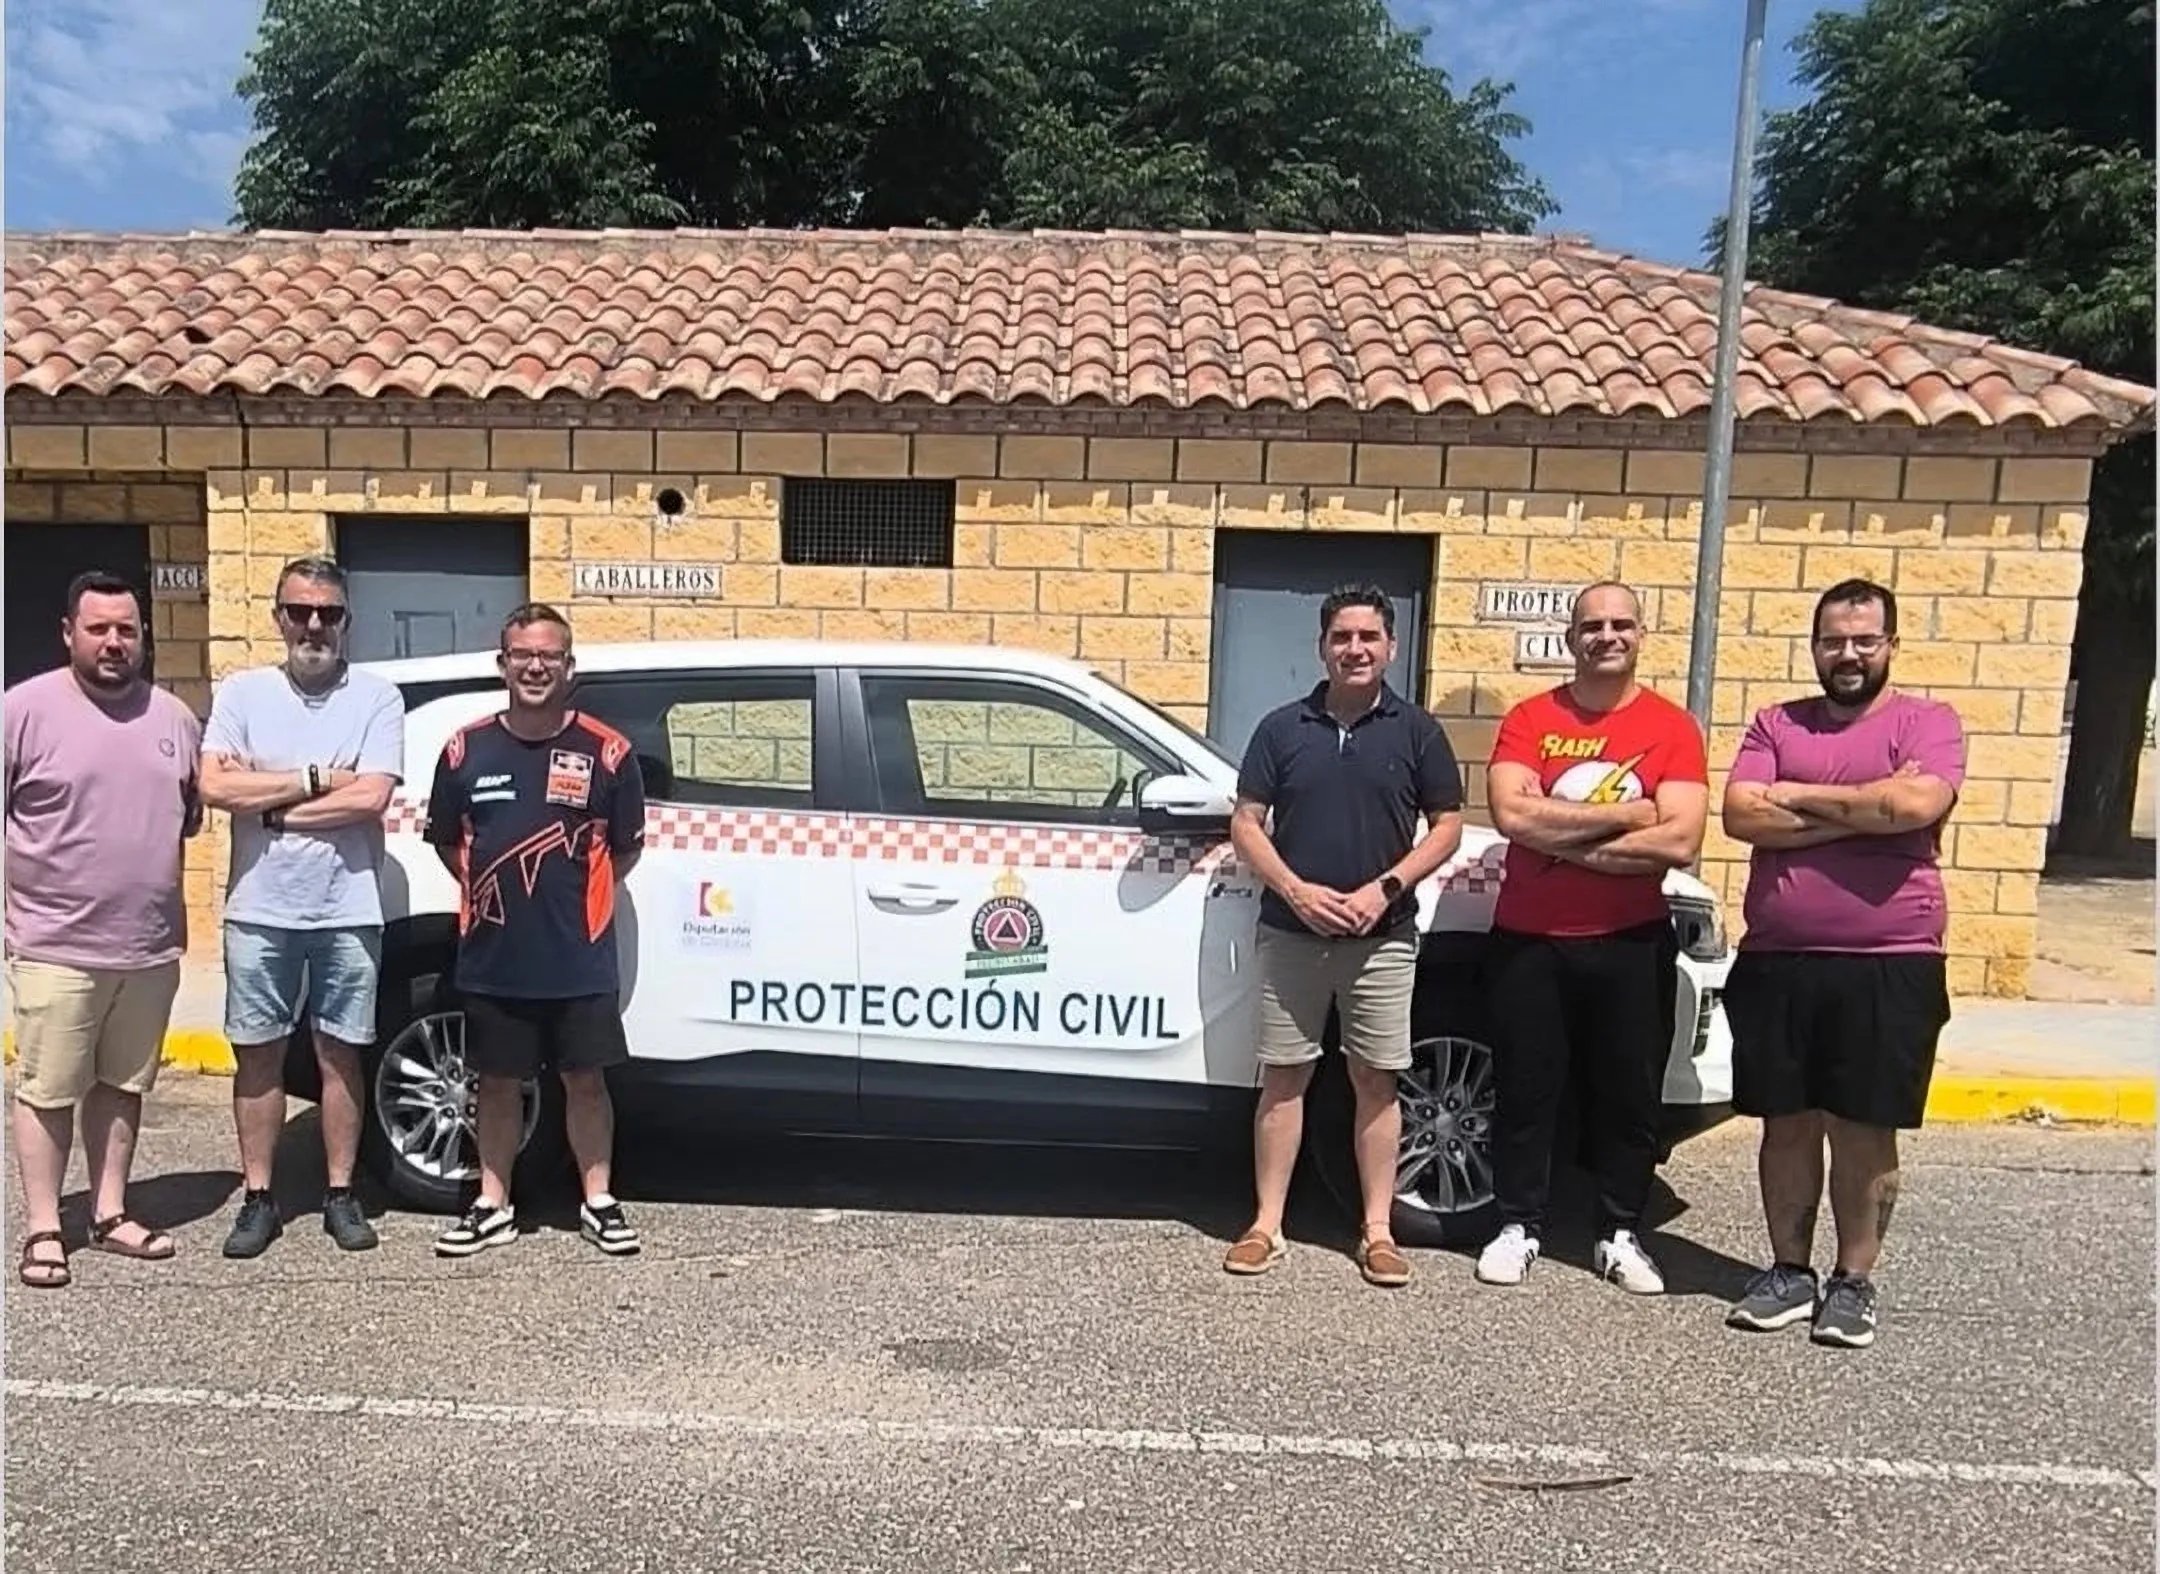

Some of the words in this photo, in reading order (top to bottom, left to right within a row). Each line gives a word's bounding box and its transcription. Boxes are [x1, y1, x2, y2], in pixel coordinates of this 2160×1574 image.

[581, 567, 714, 590] CABALLEROS
[1493, 589, 1577, 613] PROTEC
[1526, 636, 1568, 658] CIV
[1539, 733, 1608, 759] FLASH
[730, 979, 1040, 1032] PROTECCIÓN
[1059, 992, 1180, 1039] CIVIL
